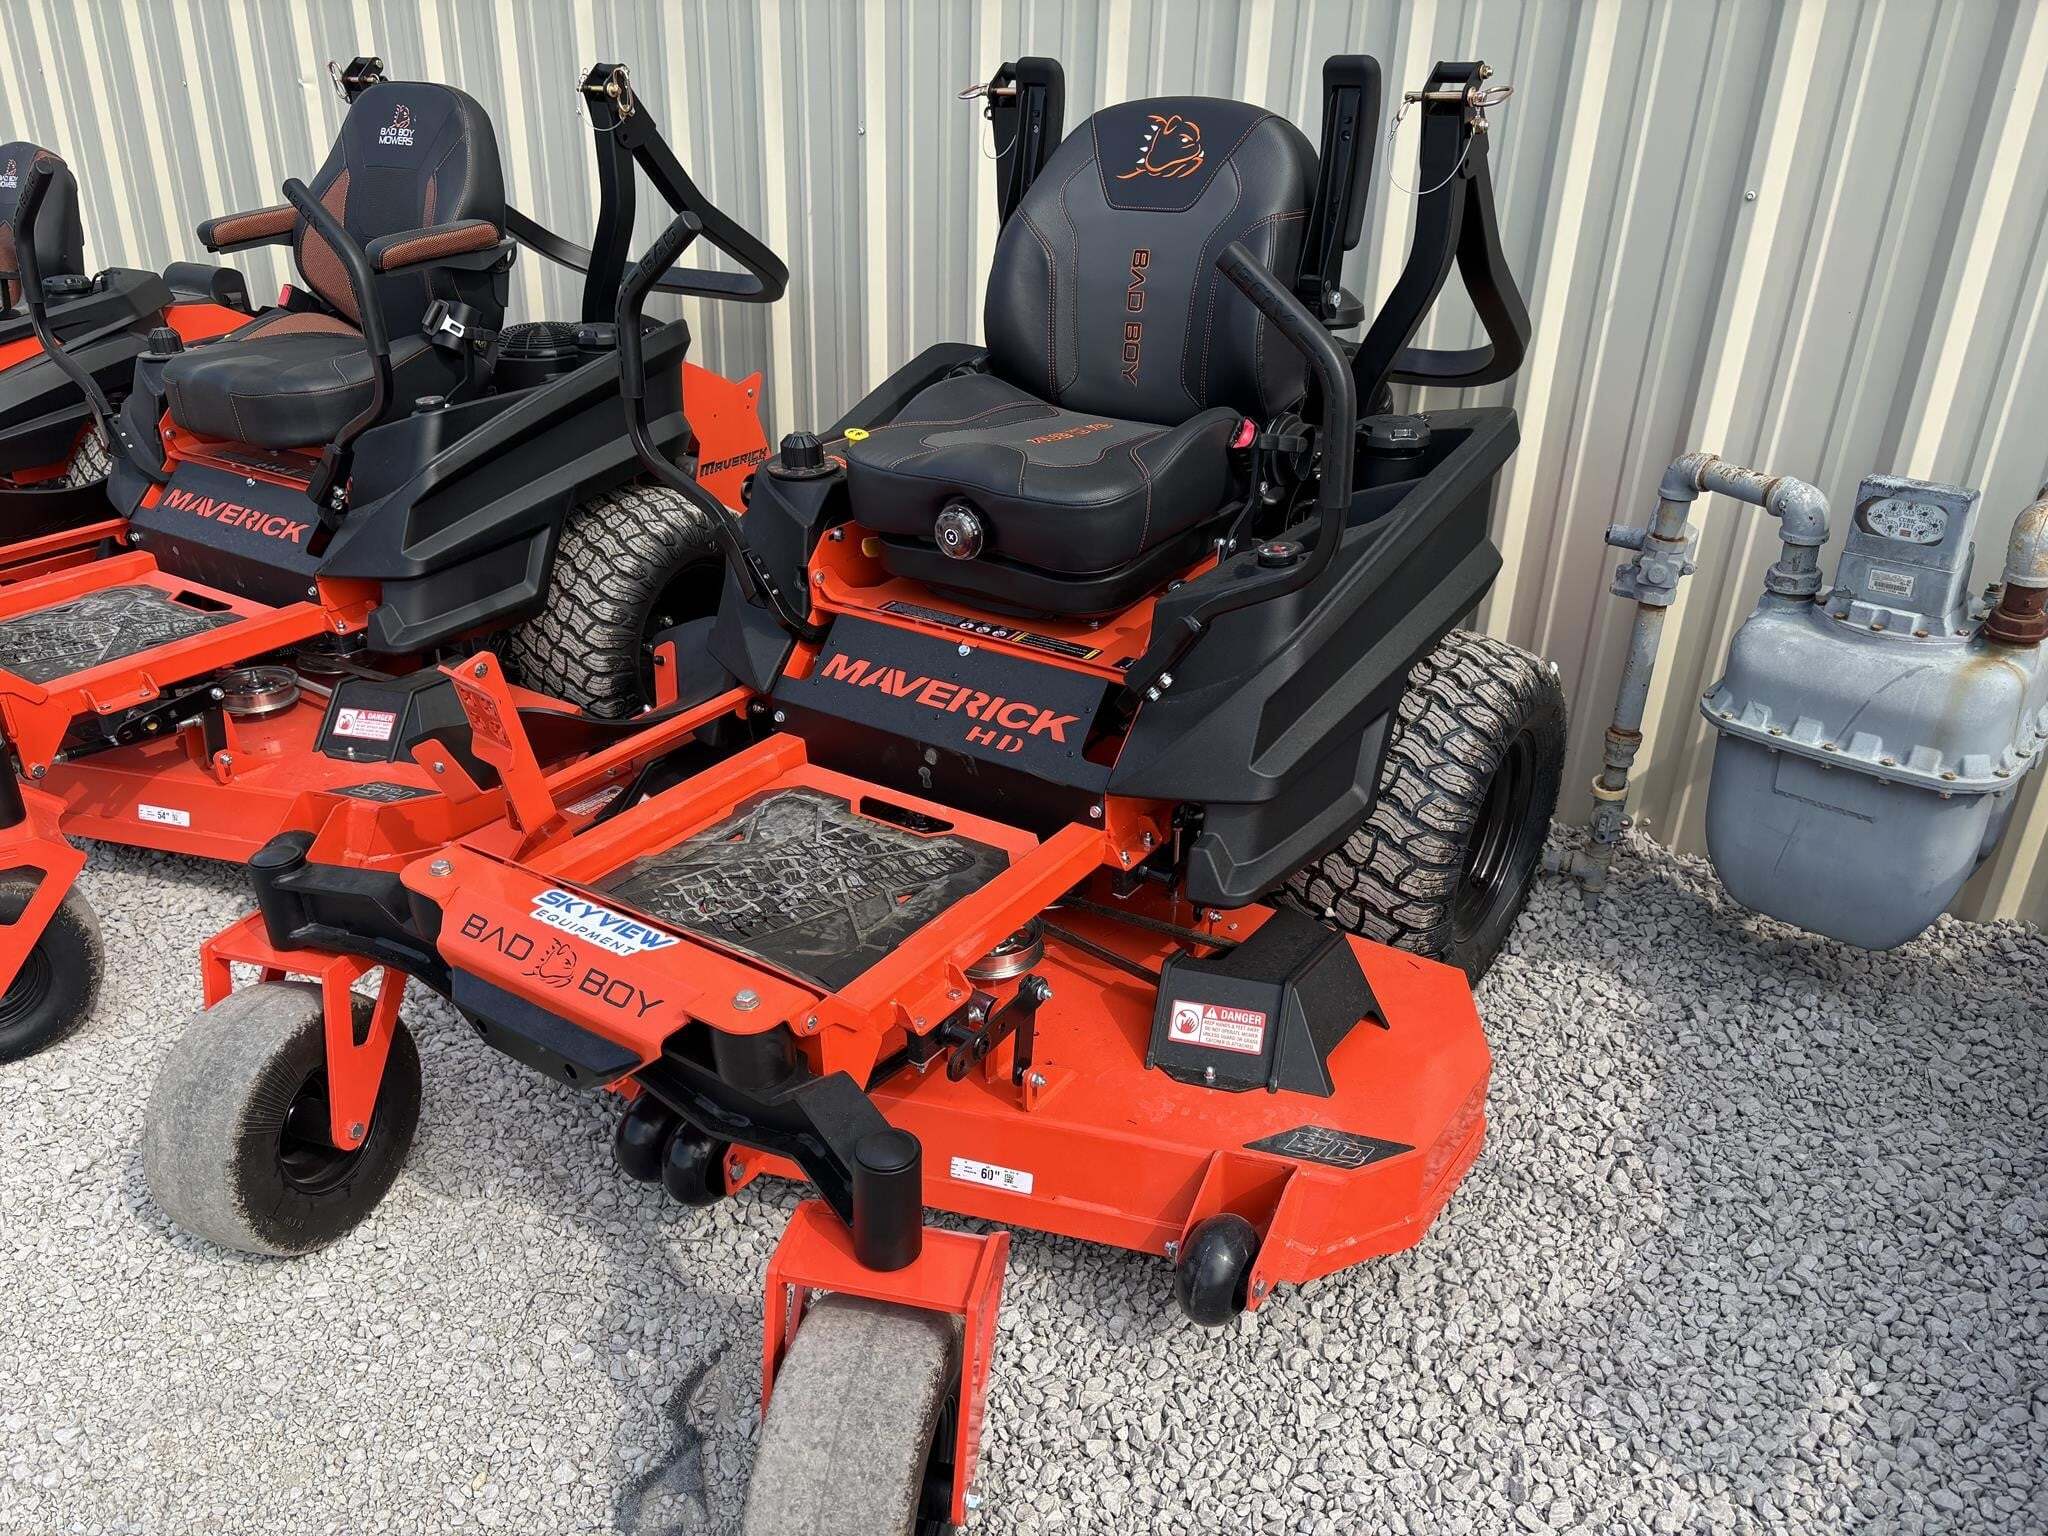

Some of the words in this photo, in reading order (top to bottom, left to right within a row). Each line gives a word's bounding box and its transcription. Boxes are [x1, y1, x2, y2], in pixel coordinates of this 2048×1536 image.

[379, 135, 414, 146] MOWERS
[380, 127, 397, 136] BAD
[398, 128, 415, 138] BOY
[1127, 248, 1150, 313] BAD
[1121, 321, 1143, 388] BOY
[700, 447, 768, 477] MAVERICK
[163, 487, 311, 544] MAVERICK
[820, 653, 1081, 743] MAVERICK
[367, 712, 394, 722] DANGER
[965, 726, 1025, 753] HD
[535, 909, 636, 954] EQUIPMENT
[538, 891, 675, 948] SKYVIEW
[460, 913, 535, 961] BAD
[578, 967, 665, 1018] BOY
[1220, 1009, 1262, 1025] DANGER
[980, 1168, 1000, 1181] 60"
